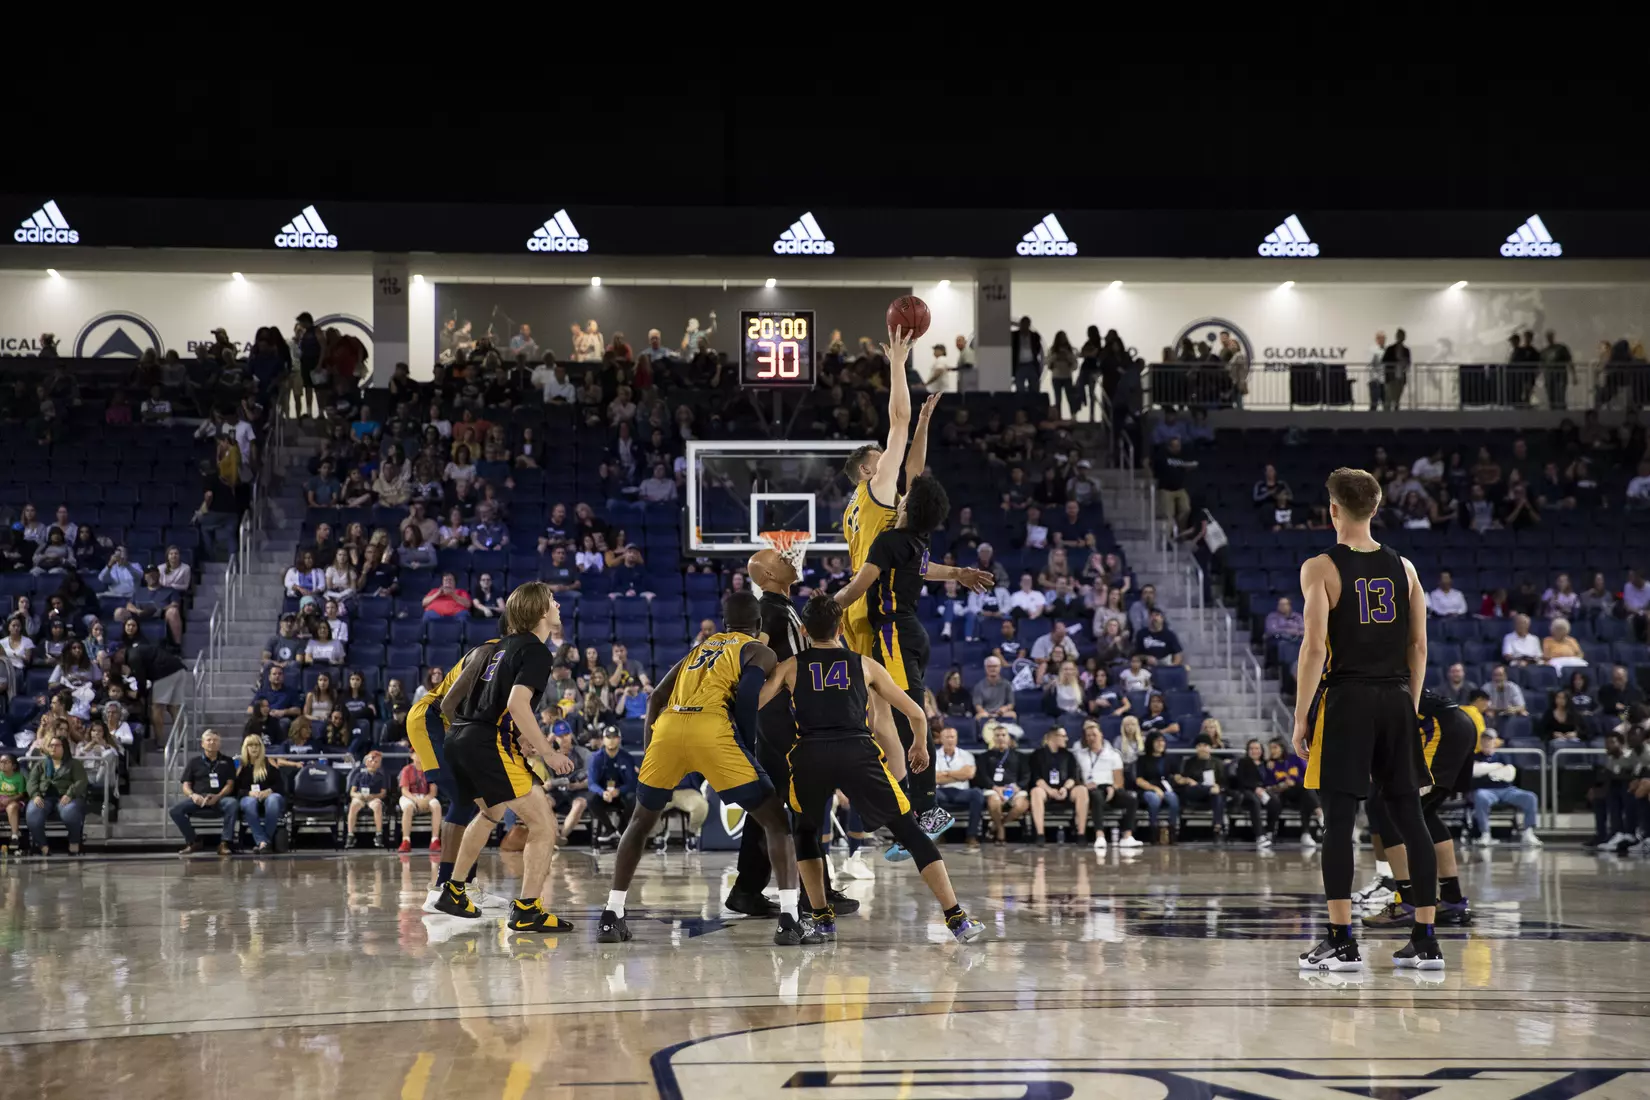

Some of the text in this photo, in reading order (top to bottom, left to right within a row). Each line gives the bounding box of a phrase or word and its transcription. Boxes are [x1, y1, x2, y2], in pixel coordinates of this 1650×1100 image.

[14, 229, 79, 243] adidas
[274, 234, 338, 248] adidas
[526, 238, 589, 252] adidas
[773, 240, 835, 254] adidas
[1016, 242, 1077, 256] adidas
[1258, 243, 1319, 257] adidas
[1500, 243, 1562, 257] adidas
[747, 318, 806, 340] 20:00
[757, 341, 799, 378] 30
[1264, 347, 1348, 360] GLOBALLY
[1355, 577, 1396, 624] 13
[687, 648, 730, 672] 31
[808, 660, 851, 691] 14
